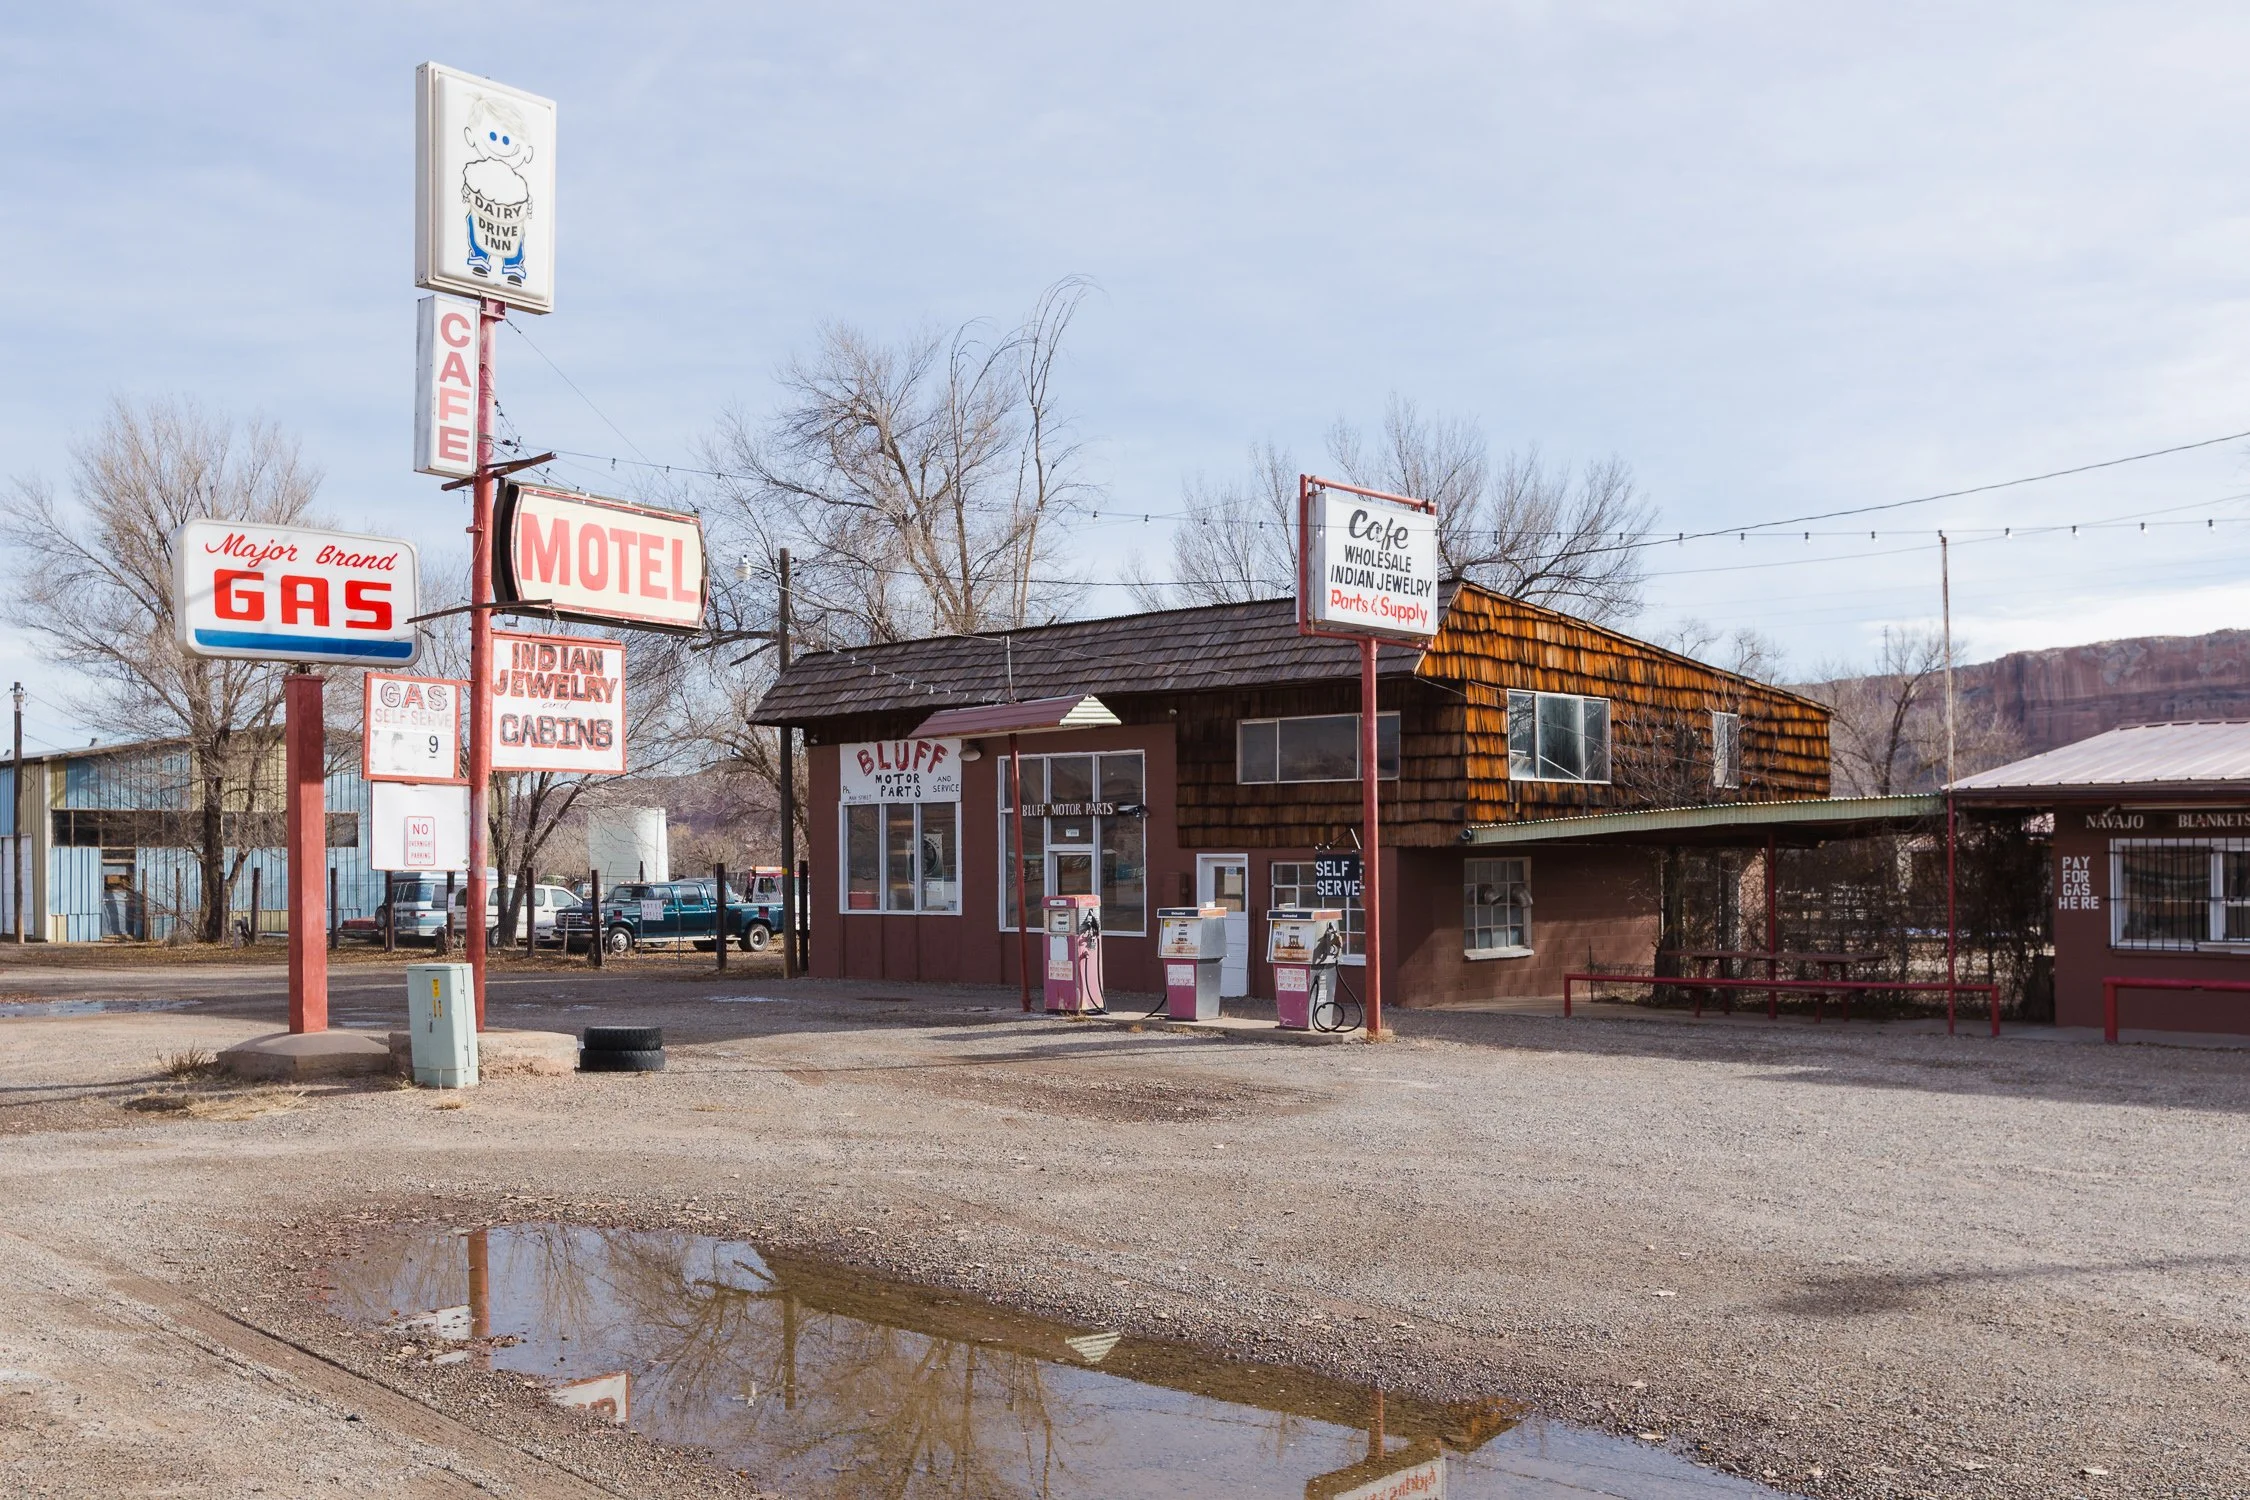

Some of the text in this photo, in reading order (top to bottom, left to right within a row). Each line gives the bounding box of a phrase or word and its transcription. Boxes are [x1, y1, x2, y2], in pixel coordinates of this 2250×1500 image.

[475, 195, 522, 219] DAIRY
[478, 216, 518, 237] DRIVE
[484, 234, 511, 251] INN
[438, 312, 472, 463] CAFE
[1349, 509, 1409, 550] Cafe
[205, 532, 398, 571] Major Brand
[521, 512, 702, 605] MOTEL
[1344, 544, 1412, 573] WHOLESALE
[1330, 565, 1432, 598] INDIAN JEWELRY
[214, 568, 393, 631] GAS
[1330, 589, 1369, 613] Parts
[1379, 596, 1428, 628] Supply
[512, 642, 604, 676] INDIAN
[380, 681, 448, 712] GAS
[492, 669, 619, 704] JEWELRY
[374, 708, 453, 729] SELF SERVE
[500, 713, 613, 752] CABINS
[857, 740, 949, 776] BLUFF
[875, 773, 920, 784] MOTOR
[932, 783, 960, 793] SERVICE
[937, 775, 952, 783] AND
[880, 785, 921, 797] PARTS
[1022, 802, 1114, 816] BLUFF MOTOR PARTS
[412, 823, 429, 835] NO
[2086, 815, 2144, 829] NAVAJO
[1315, 860, 1350, 877] SELF
[2062, 857, 2090, 870] PAY
[2062, 870, 2090, 883] FOR
[1316, 880, 1360, 896] SERVE
[2063, 883, 2091, 896] GAS
[2058, 896, 2099, 910] HERE
